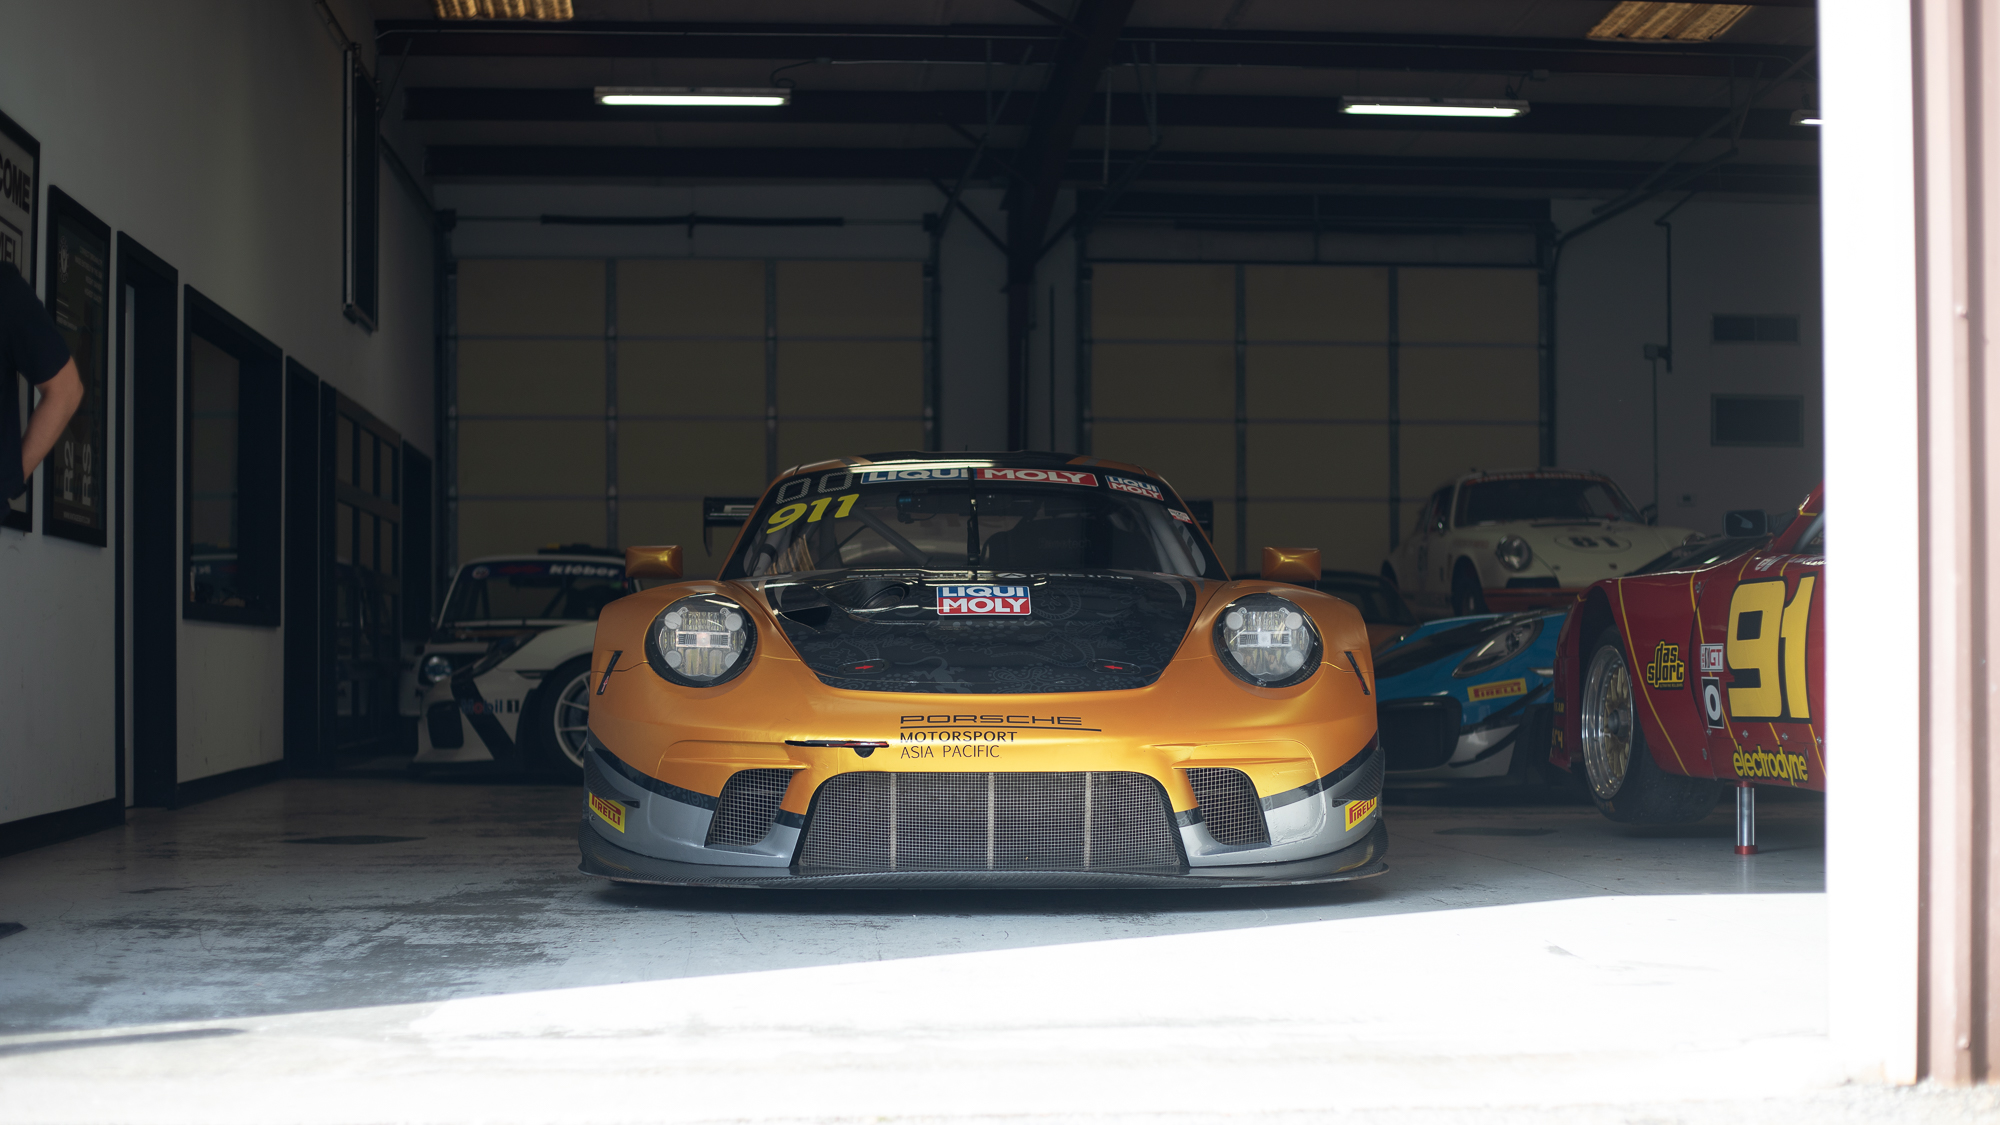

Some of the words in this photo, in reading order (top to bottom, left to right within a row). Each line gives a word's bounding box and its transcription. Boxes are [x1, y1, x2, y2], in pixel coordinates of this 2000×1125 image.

[868, 470, 968, 482] LIQUI
[984, 469, 1087, 483] MOLY
[1108, 476, 1160, 493] LIQUI
[1111, 483, 1160, 499] MOLY
[766, 493, 860, 534] 911
[942, 586, 1025, 597] LIQUI
[943, 598, 1028, 613] MOLY
[1726, 573, 1817, 722] 91
[1474, 682, 1521, 698] PIRELLI
[459, 699, 503, 715] Mobil
[900, 715, 1083, 725] PORSCHE
[900, 731, 1018, 743] MOTORSPORT
[900, 745, 934, 759] ASIA
[942, 744, 1000, 758] PACIFIC
[1733, 745, 1808, 786] electrodyne
[591, 794, 622, 826] PIRELLI
[1349, 798, 1375, 824] PIRELLI
